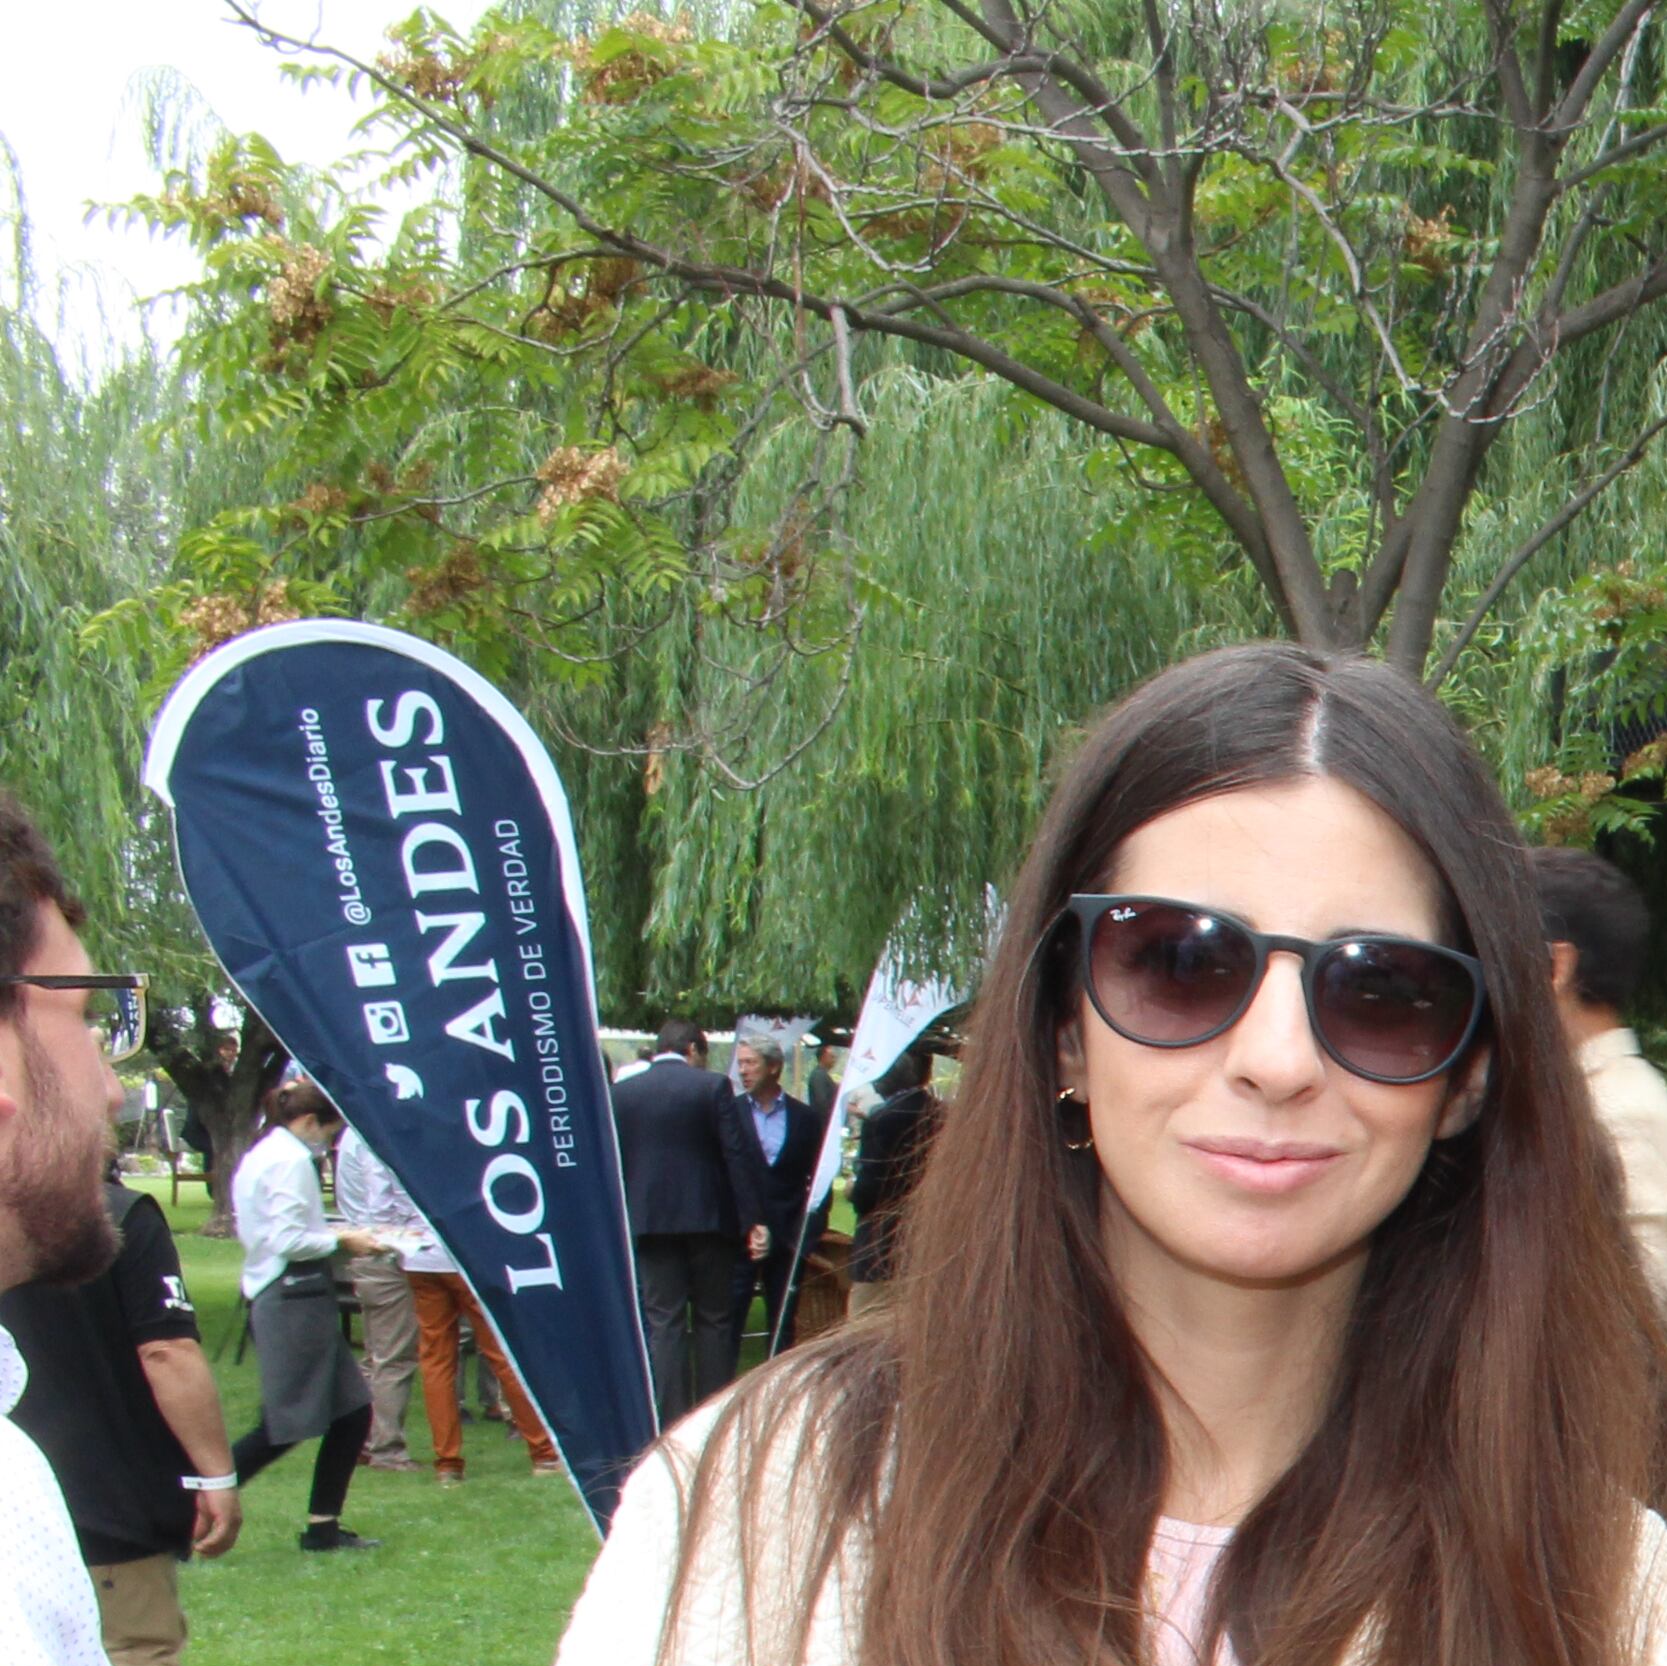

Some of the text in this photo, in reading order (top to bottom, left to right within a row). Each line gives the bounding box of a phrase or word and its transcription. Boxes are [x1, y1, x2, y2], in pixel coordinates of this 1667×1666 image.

[300, 707, 371, 926] @LosAndesDiario
[366, 689, 563, 1295] LOS ANDES
[494, 818, 577, 1168] PERIODISMO DE VERDAD
